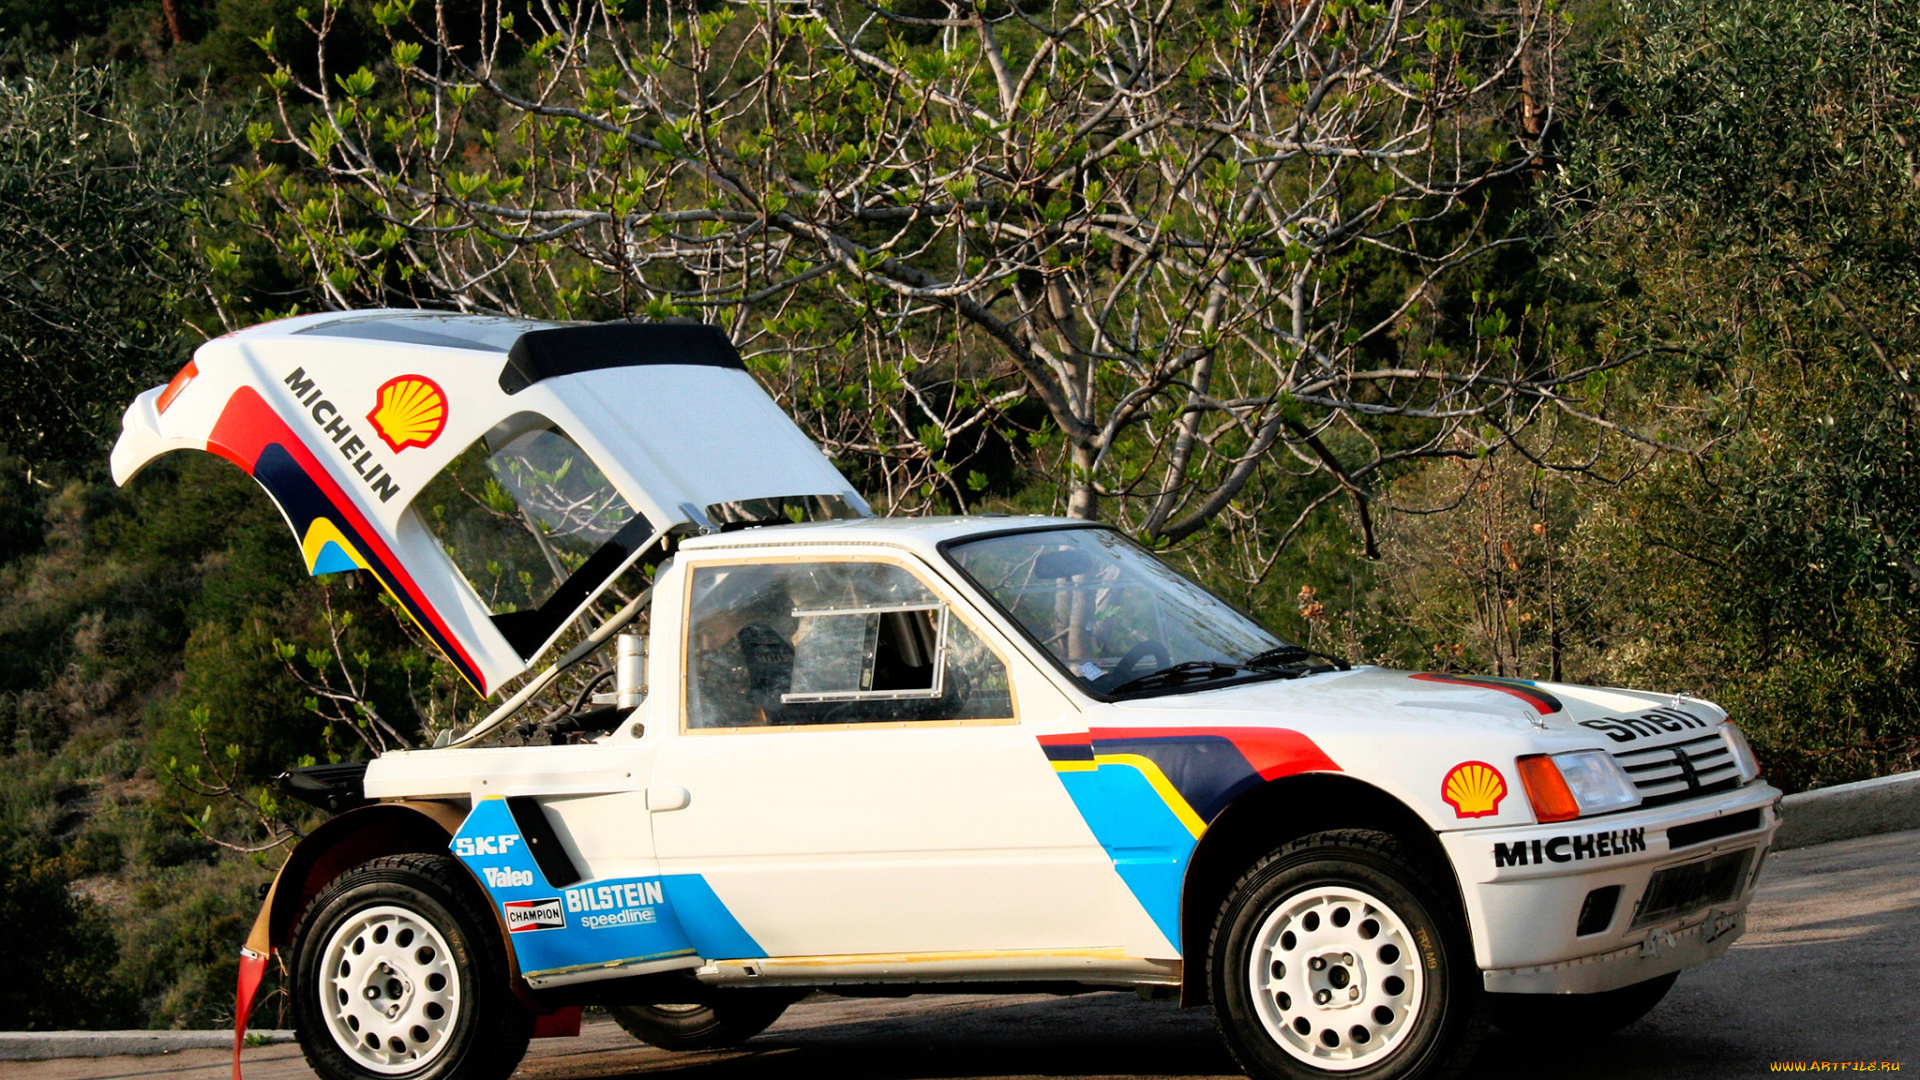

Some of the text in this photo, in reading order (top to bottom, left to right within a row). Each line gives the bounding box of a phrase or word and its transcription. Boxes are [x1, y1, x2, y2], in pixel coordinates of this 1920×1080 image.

[284, 366, 401, 503] MICHELIN
[1578, 707, 1707, 743] Shell
[455, 834, 520, 857] SKF
[1494, 827, 1646, 868] MICHELIN
[482, 866, 534, 889] Valeo
[564, 881, 664, 912] BILSTEIN
[510, 907, 560, 923] CHAMPION
[581, 909, 653, 929] speedline
[1416, 926, 1433, 951] TRX
